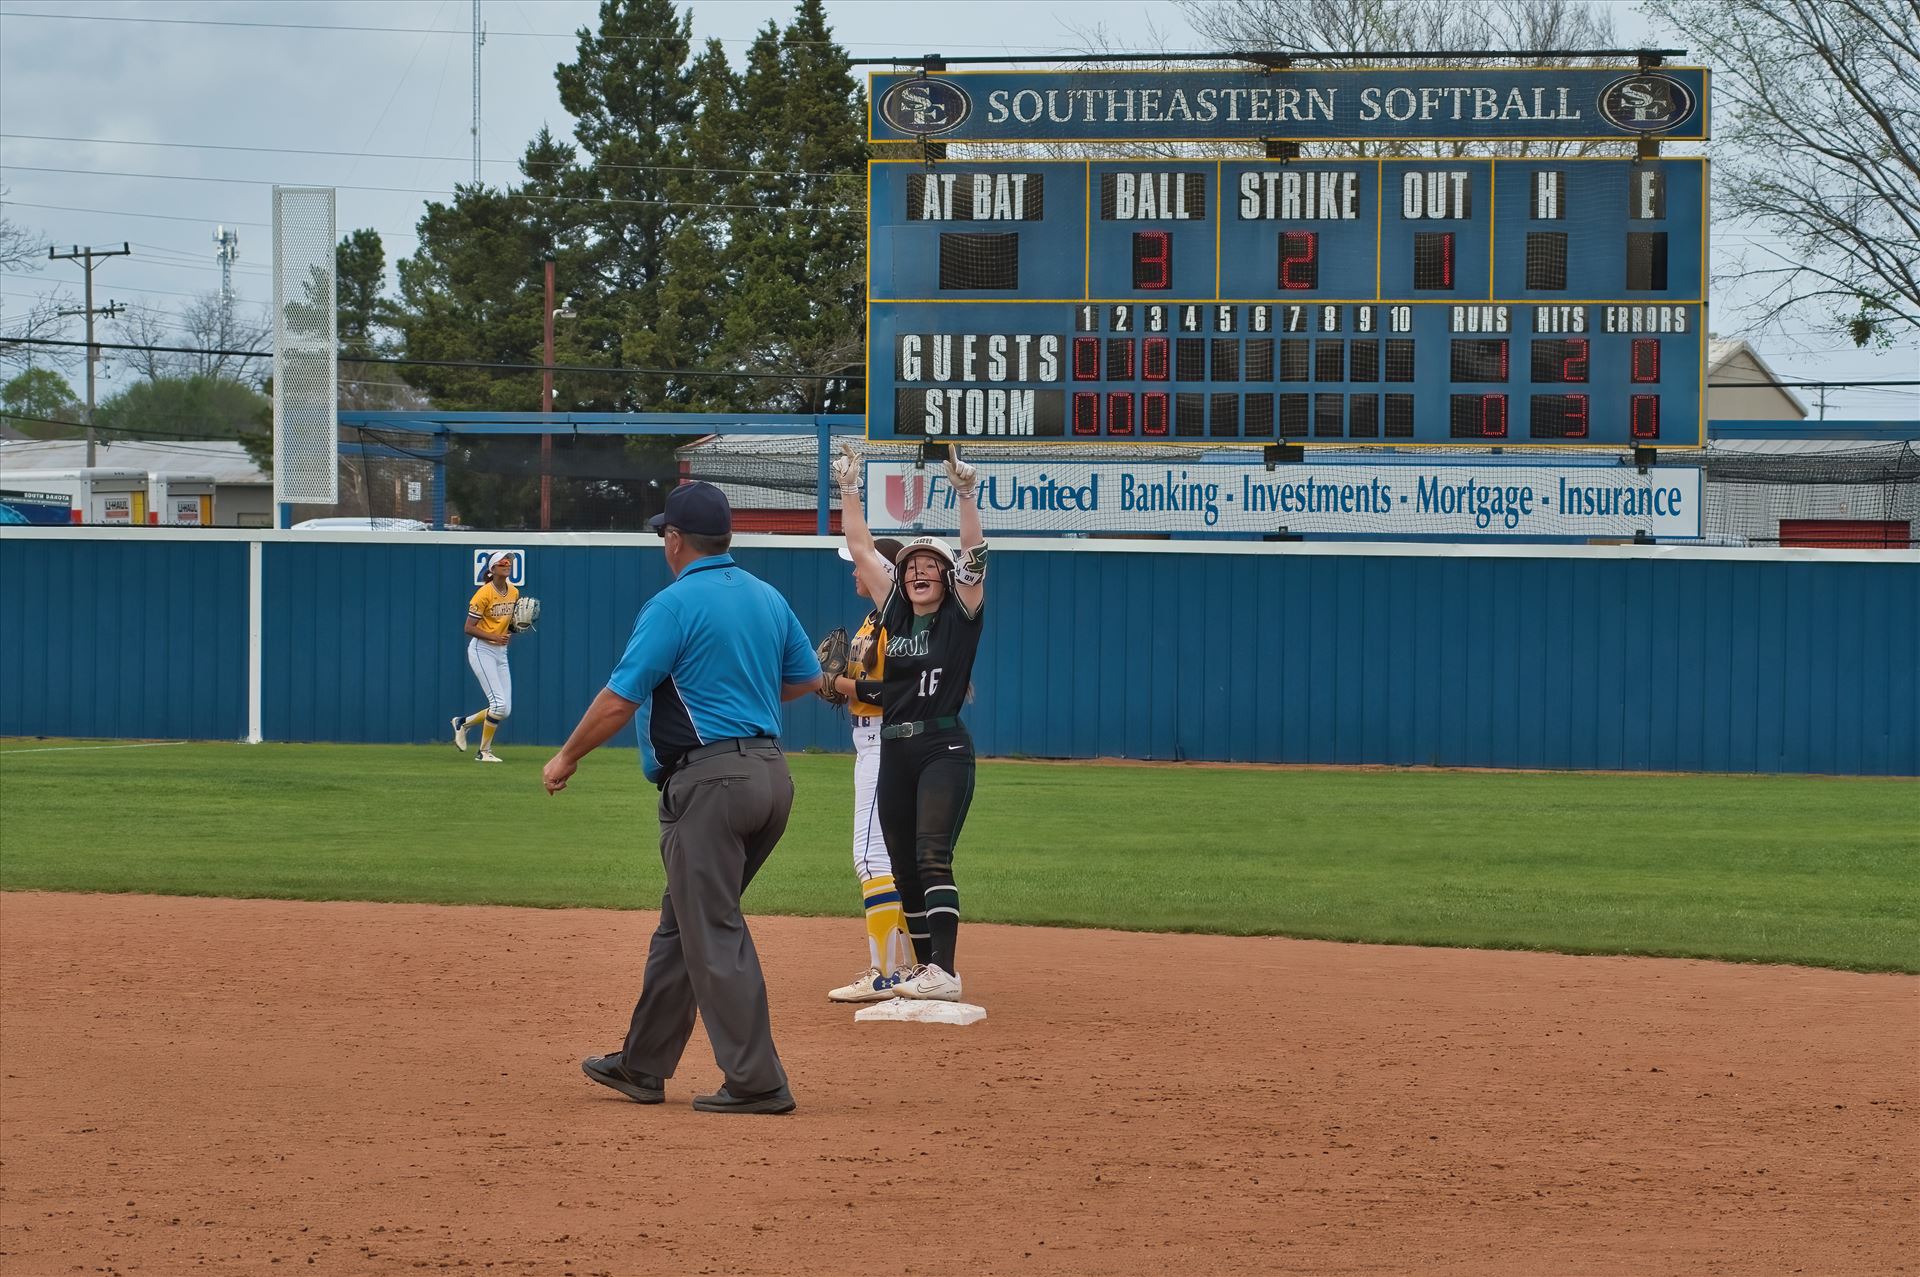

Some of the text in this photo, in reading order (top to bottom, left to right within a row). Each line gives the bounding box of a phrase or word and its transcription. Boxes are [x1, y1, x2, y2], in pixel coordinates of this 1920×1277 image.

[987, 87, 1581, 123] SOUTHEASTERN SOFTBALL
[923, 173, 1027, 220] AT BAT
[1116, 172, 1190, 219] BALL
[1241, 171, 1357, 219] STRIKE
[1403, 171, 1468, 219] OUT
[1538, 171, 1557, 218] H
[1641, 171, 1655, 218] E
[1140, 232, 1167, 288] 3
[1283, 232, 1314, 288] 2
[1083, 306, 1686, 333] 1 2 3 4 5 6 7 8 9 10 RUNS HITS ERRORS
[903, 335, 1058, 382] GUESTS
[1564, 339, 1587, 381] 2
[925, 389, 1035, 435] STORM
[1565, 394, 1586, 436] 3
[926, 470, 1682, 529] FirtUnited Banking Investments Mortgage Insurance
[476, 552, 523, 583] 20
[918, 668, 942, 696] 16
